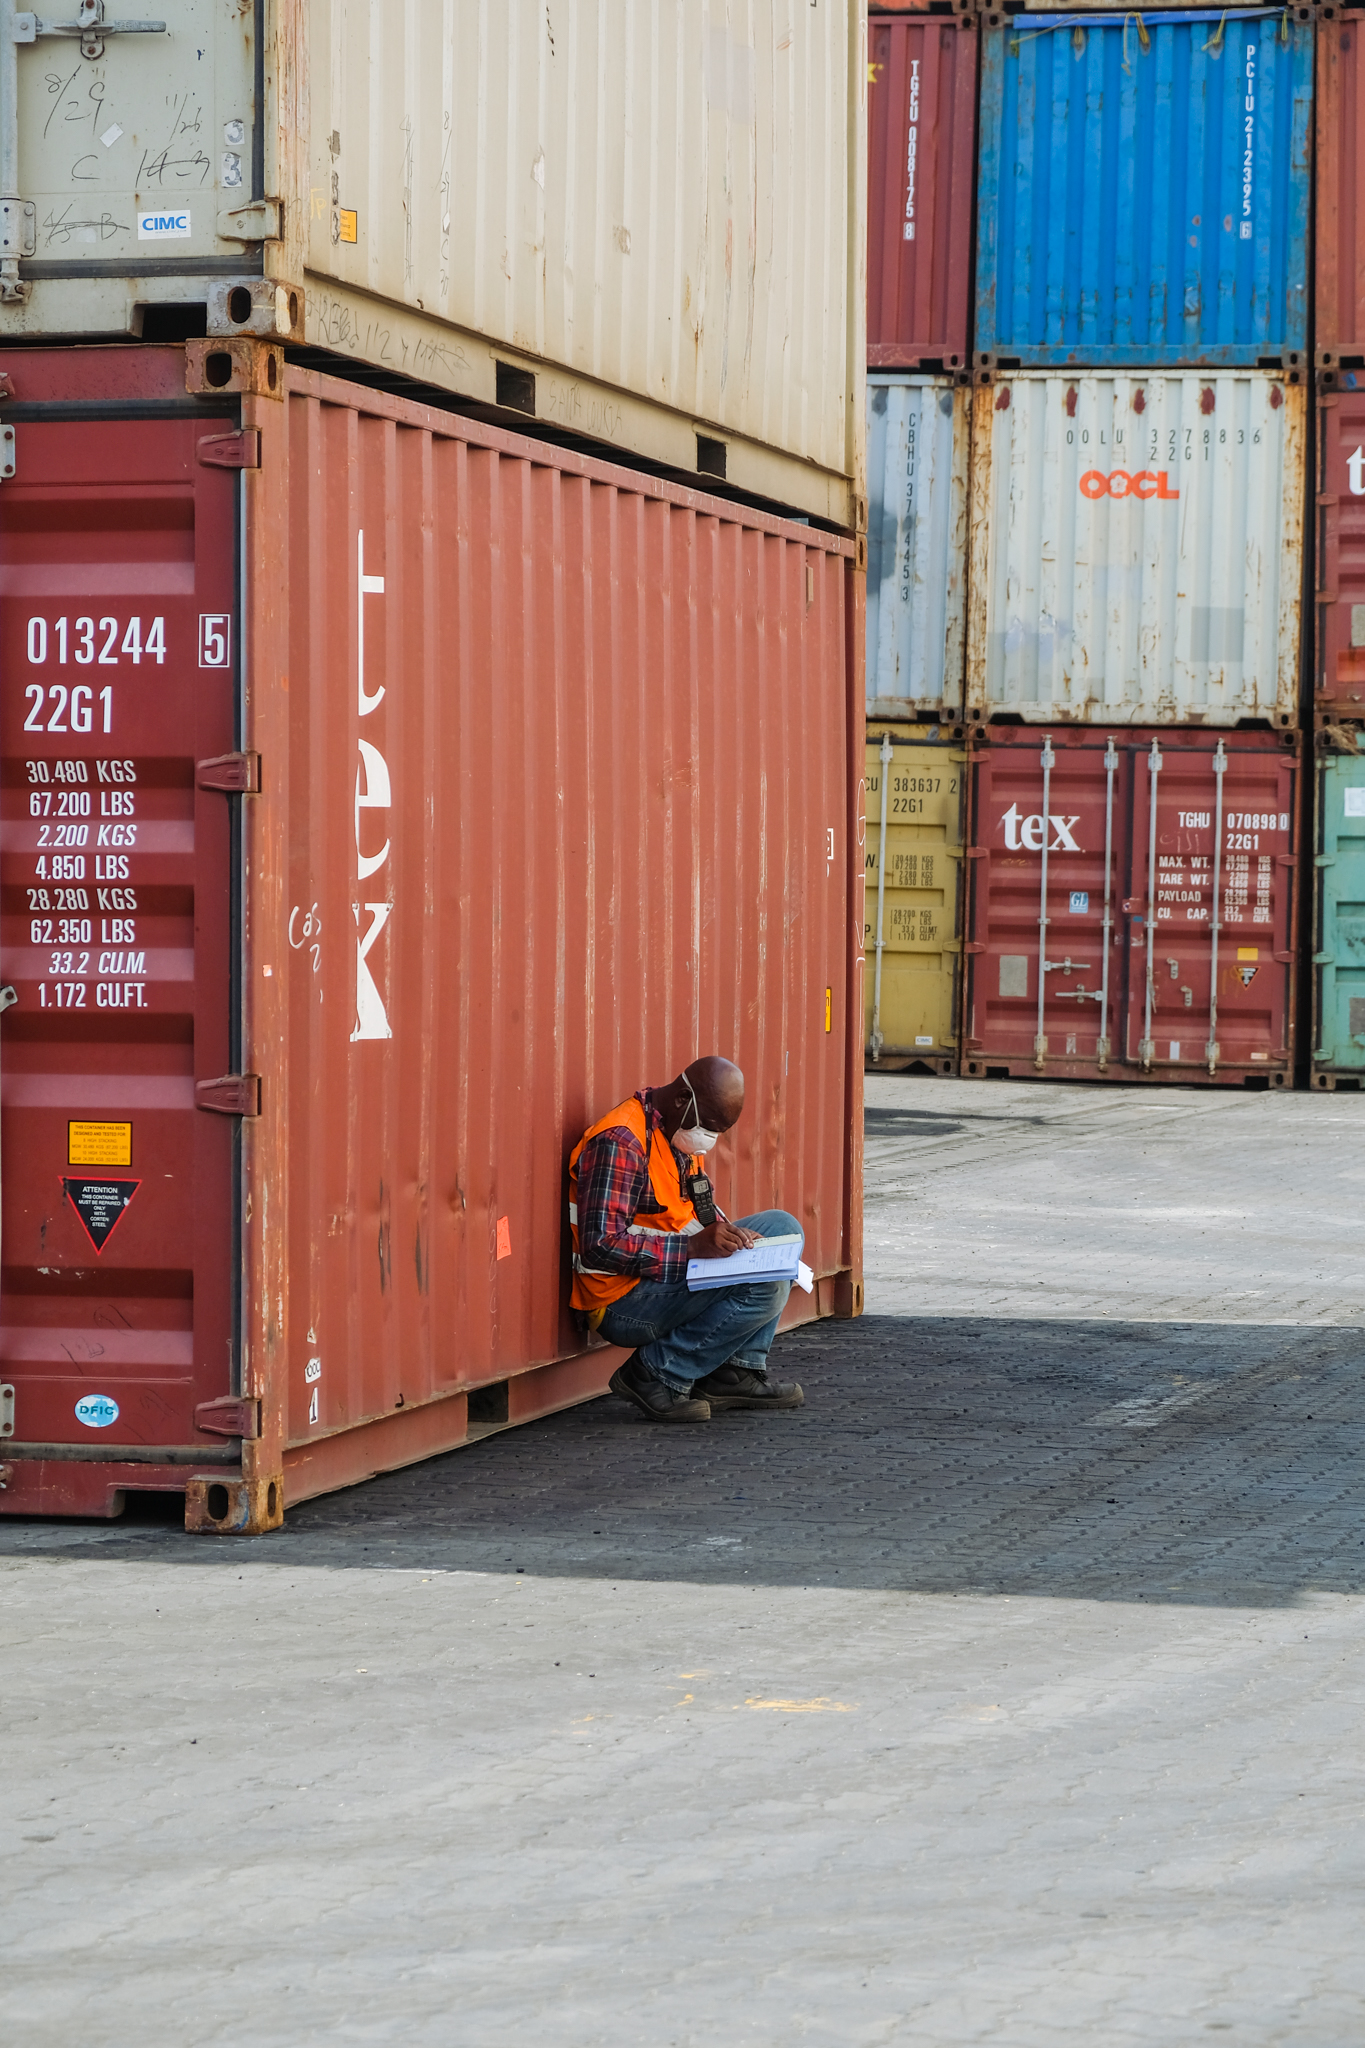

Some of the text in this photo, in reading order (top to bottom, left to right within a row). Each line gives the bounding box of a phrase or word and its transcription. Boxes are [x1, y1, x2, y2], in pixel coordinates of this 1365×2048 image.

[1245, 44, 1256, 112] PCIU
[904, 60, 920, 240] TGCU 008175 8
[1242, 115, 1254, 217] 212395
[142, 216, 187, 231] CIMC
[907, 412, 917, 477] CBHU
[1150, 445, 1209, 461] 22G1
[1079, 469, 1180, 500] OOCL
[903, 482, 913, 580] 37445
[27, 616, 226, 665] 013244 5
[24, 684, 113, 733] 22G1
[96, 760, 137, 783] KGS
[894, 777, 941, 793] 383637
[949, 778, 958, 793] 2
[100, 791, 135, 816] LBS
[893, 798, 923, 813] 22G1
[1001, 802, 1081, 851] tex
[1178, 811, 1210, 829] TGHU
[1226, 812, 1277, 830] 070898
[96, 824, 137, 847] KGS
[1226, 833, 1259, 850] 22G1
[95, 854, 129, 880] LBS
[1159, 856, 1186, 868] MAX.
[1190, 856, 1211, 869] WT.
[1159, 873, 1183, 885] TARE
[1190, 873, 1210, 885] WT.
[96, 887, 137, 911] KGS
[1071, 892, 1088, 906] GL
[1158, 890, 1202, 902] PAYLOAD
[1157, 907, 1172, 919] CU.
[1186, 908, 1209, 920] CAP.
[101, 918, 136, 943] LBS
[48, 951, 90, 974] 33.2
[80, 1405, 114, 1416] DFIC
